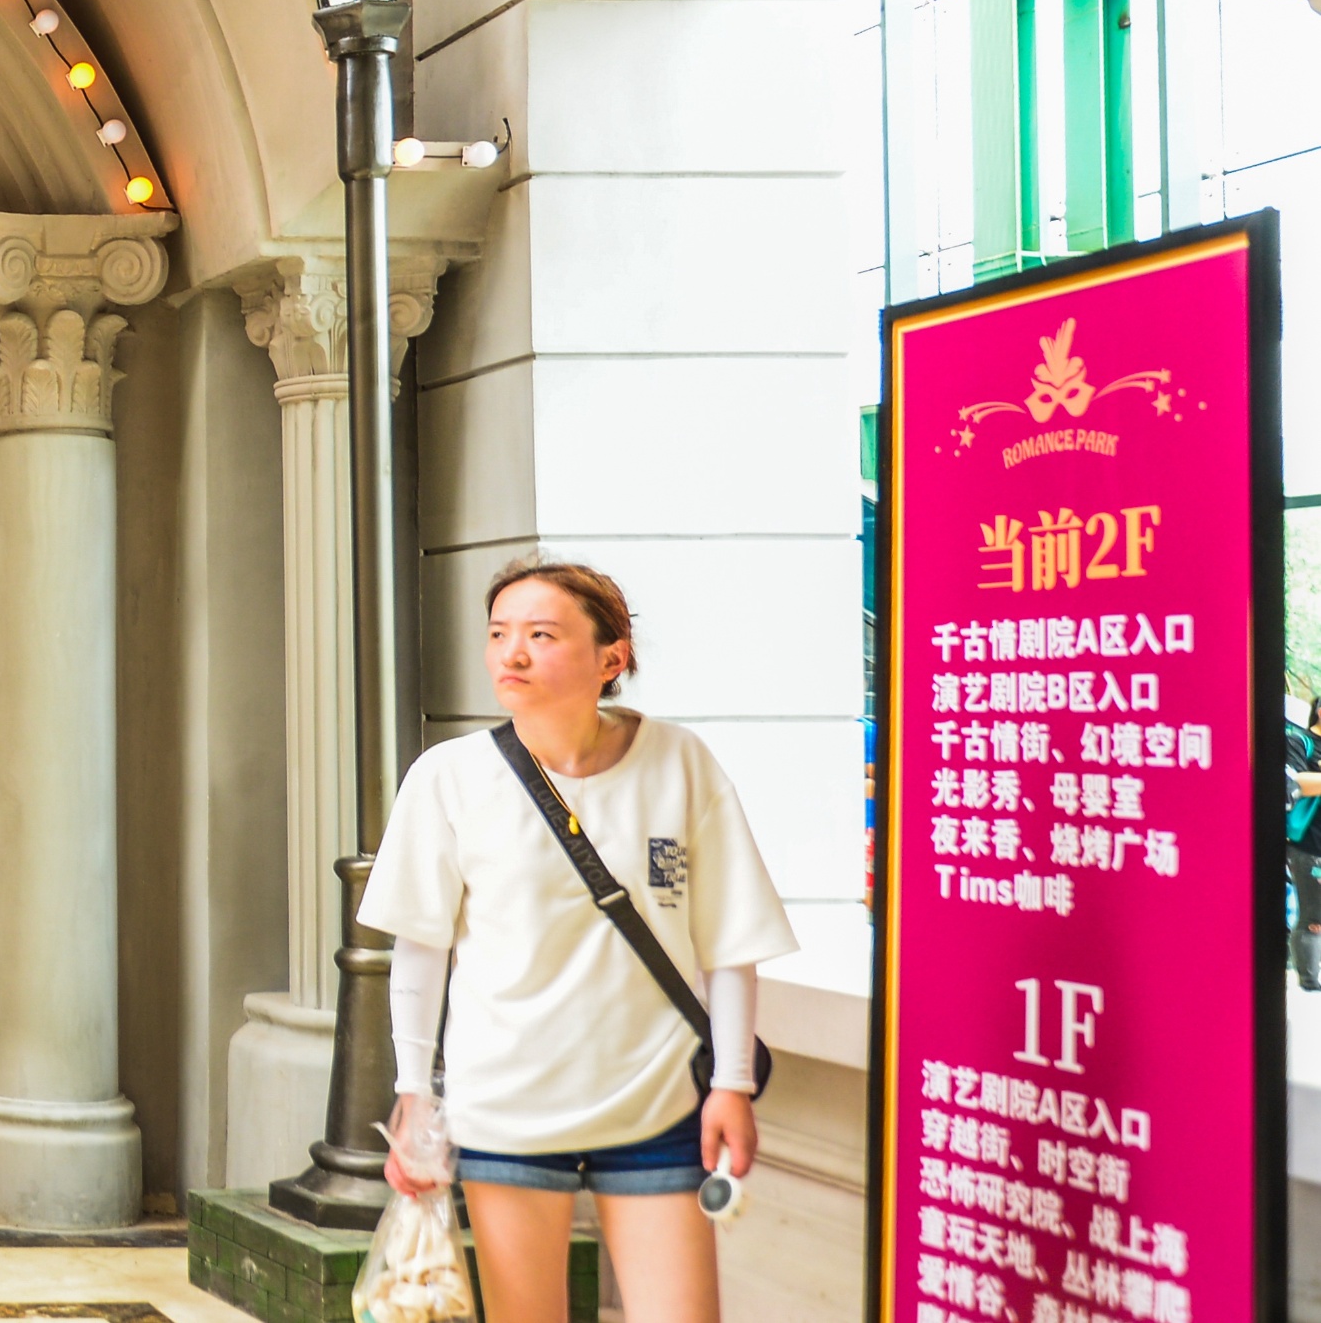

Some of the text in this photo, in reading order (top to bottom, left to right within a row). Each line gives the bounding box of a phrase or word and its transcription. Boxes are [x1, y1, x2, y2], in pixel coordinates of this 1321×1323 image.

[1001, 428, 1120, 470] ROMANCE PARK
[976, 504, 1162, 593] 当前2F
[930, 613, 1195, 663] 千古情剧院A区入口
[931, 669, 1160, 714] 演艺剧院B区入口
[1012, 977, 1106, 1075] 1F
[921, 1059, 1151, 1152] 演艺剧院A区入口
